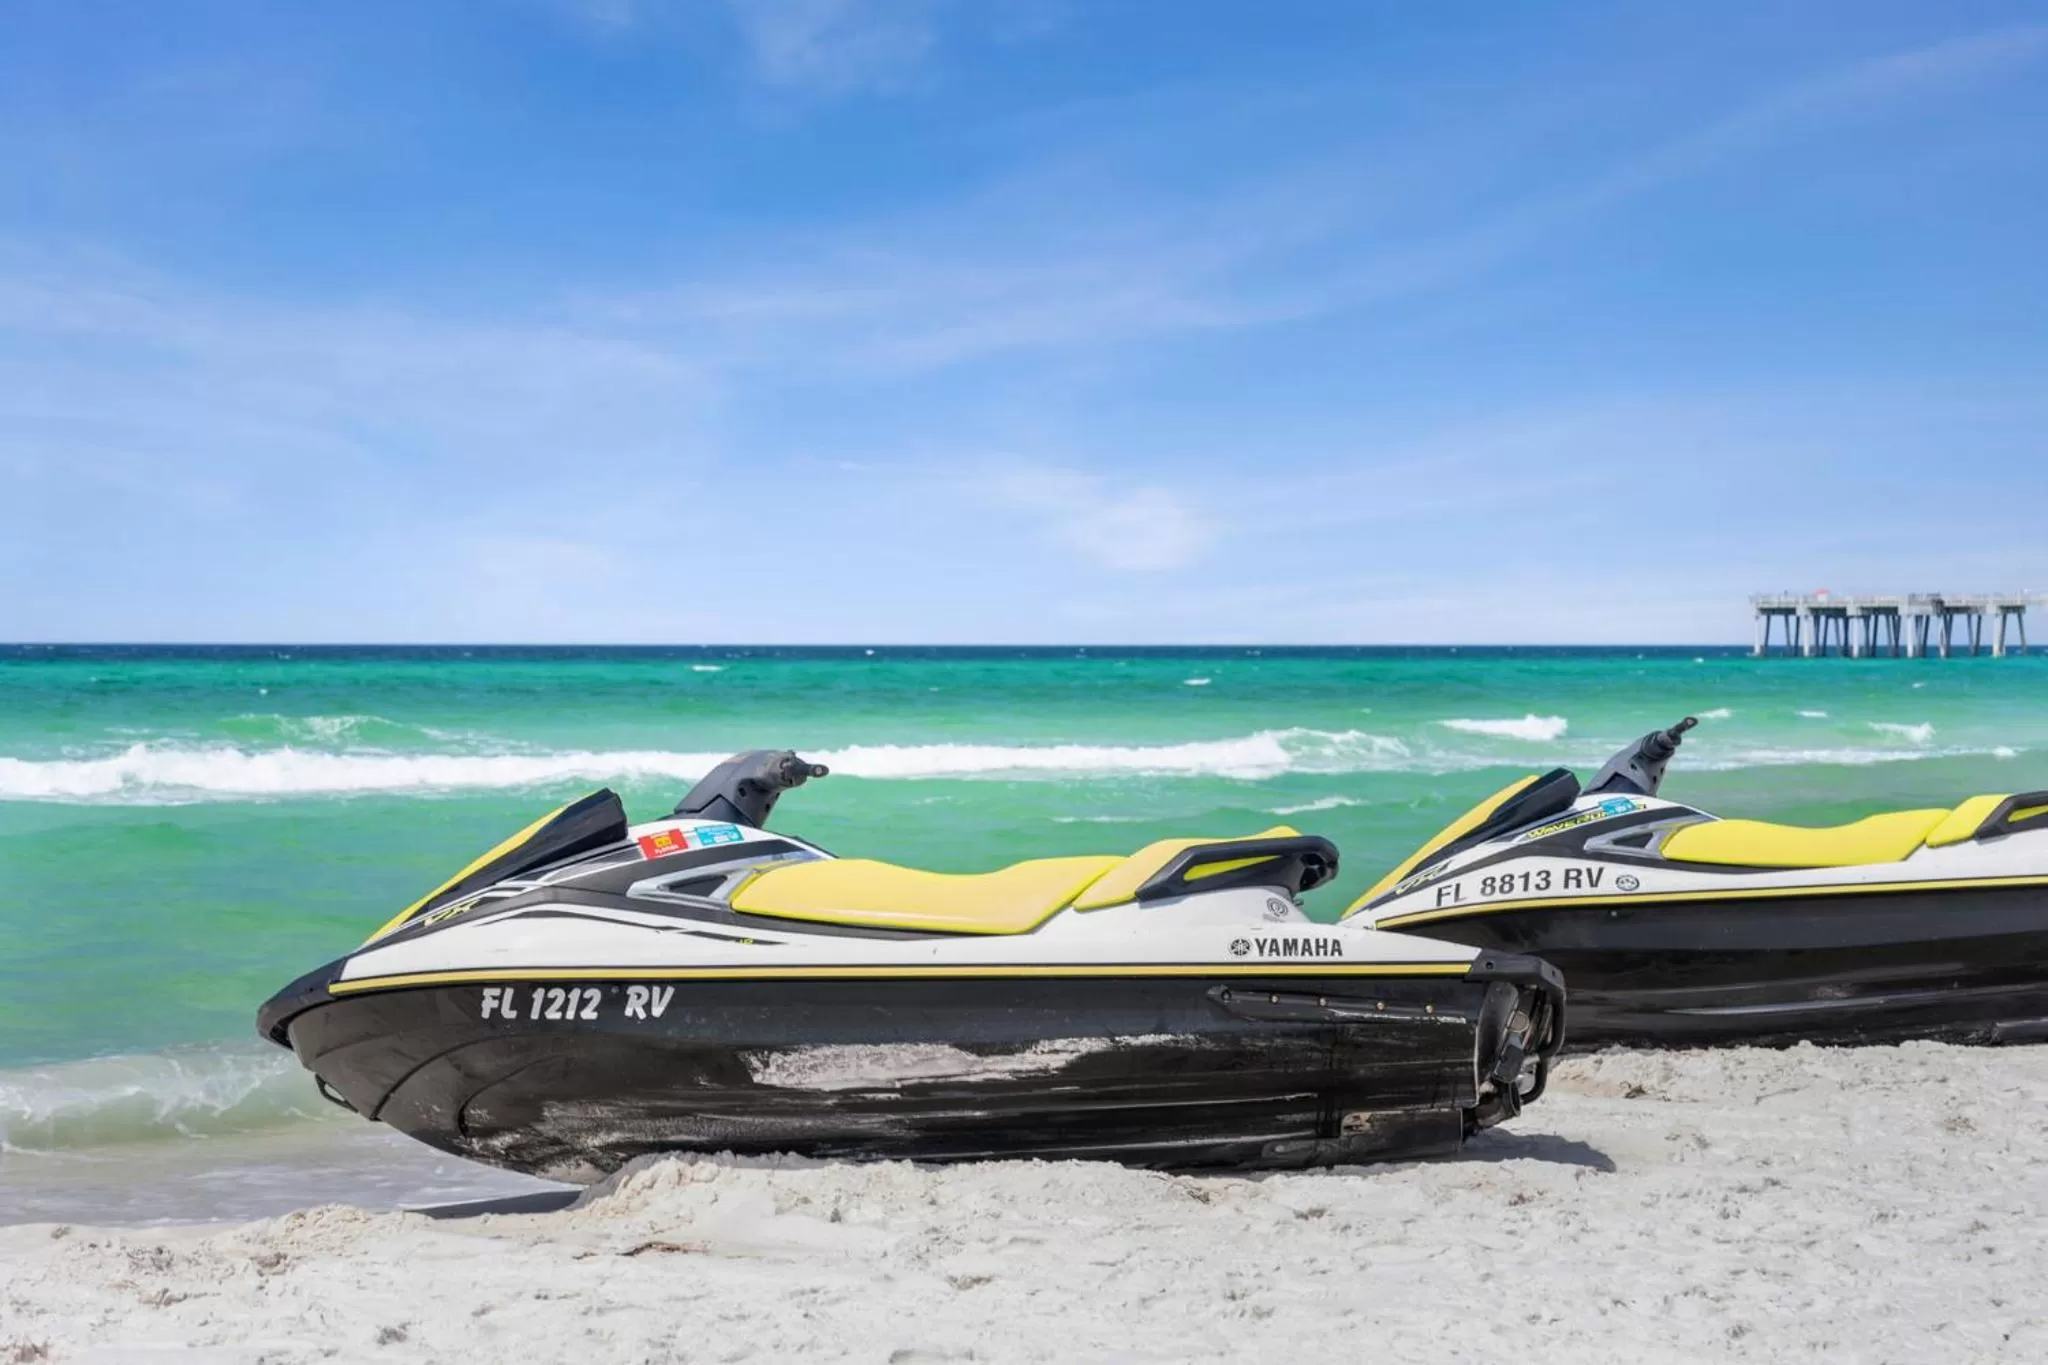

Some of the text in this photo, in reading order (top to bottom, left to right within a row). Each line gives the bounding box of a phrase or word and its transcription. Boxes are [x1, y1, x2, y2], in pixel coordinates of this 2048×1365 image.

[1436, 867, 1604, 907] FL 8813 RV
[1254, 938, 1343, 957] YAMAHA
[481, 985, 675, 1020] FL 1212 RV
